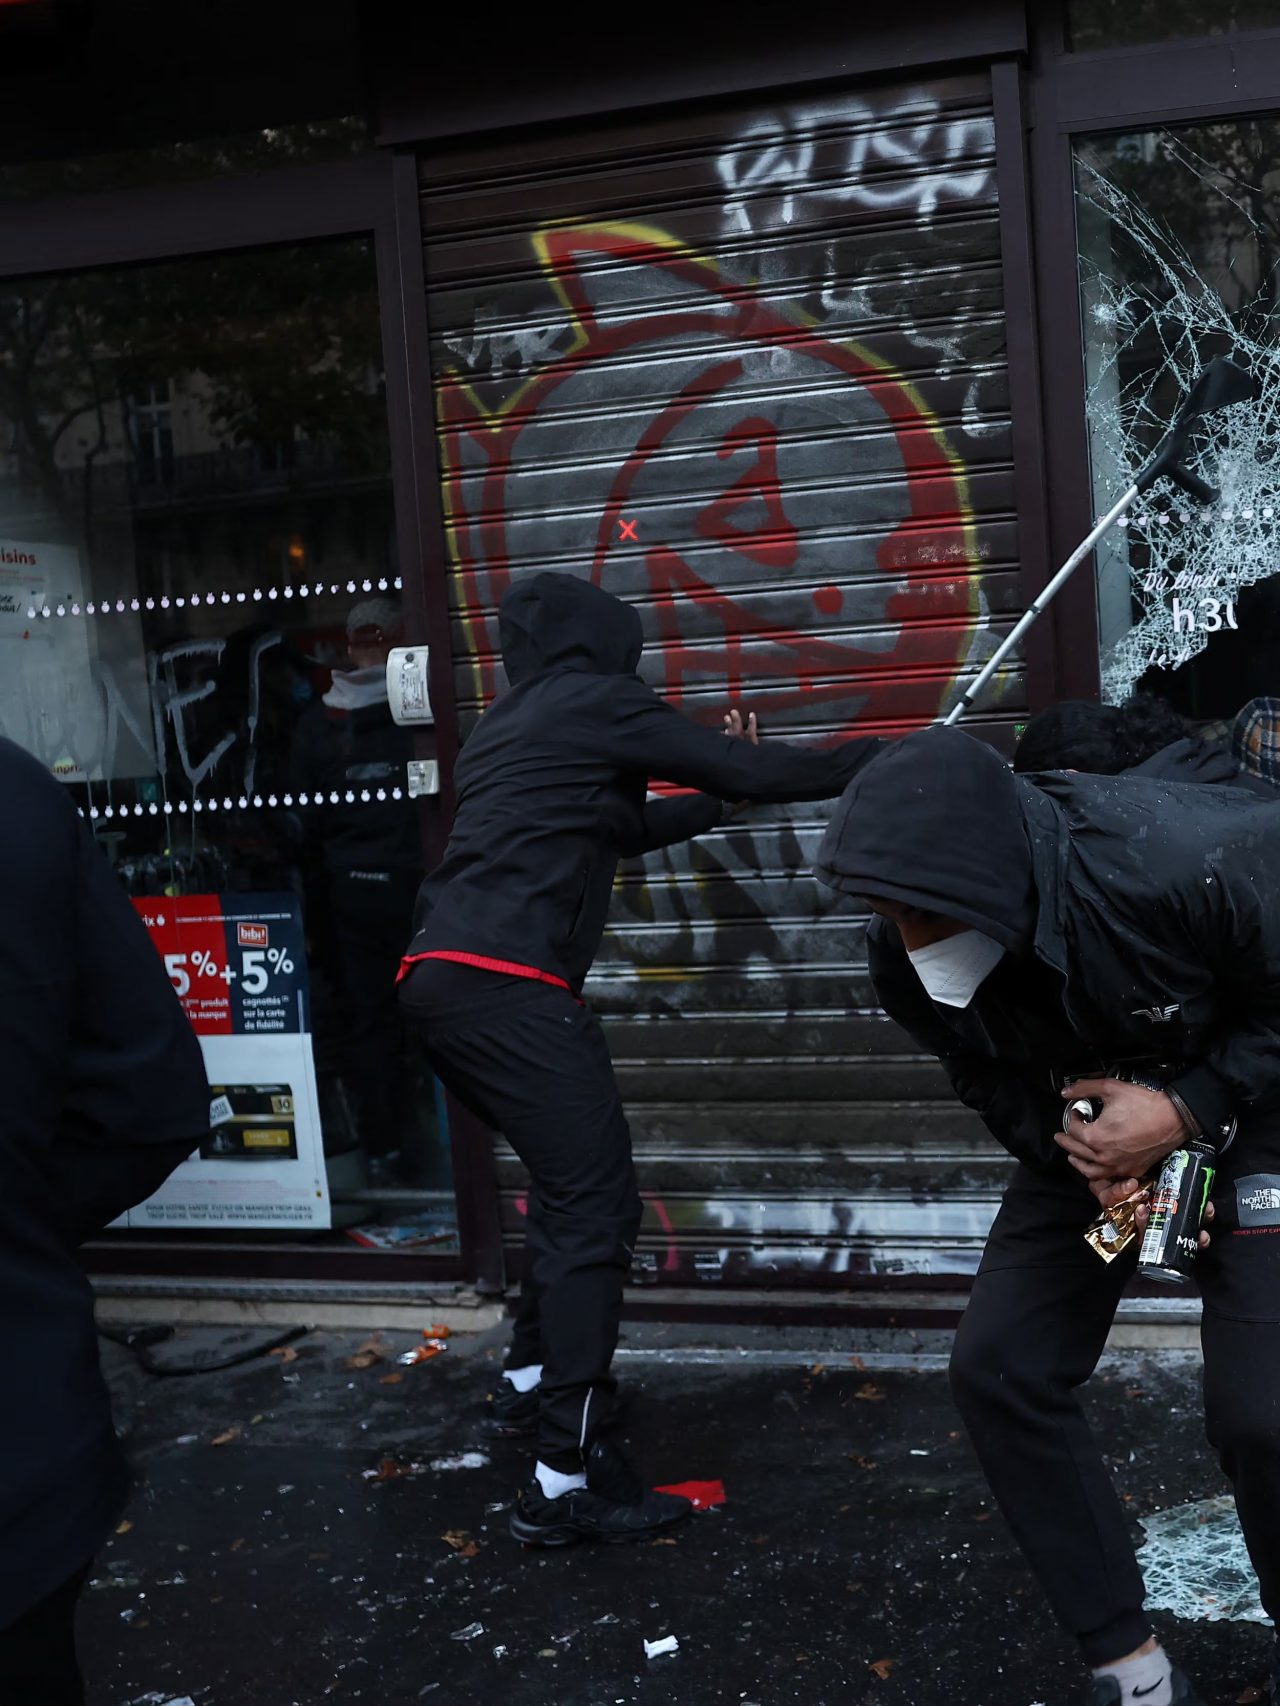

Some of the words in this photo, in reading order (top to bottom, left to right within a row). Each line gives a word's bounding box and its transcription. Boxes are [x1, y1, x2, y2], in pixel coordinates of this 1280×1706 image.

[1143, 572, 1169, 592] Du
[241, 947, 295, 996] 5%
[1254, 1188, 1271, 1197] THE
[1241, 1195, 1271, 1206] NORTH
[1250, 1201, 1272, 1211] FACE
